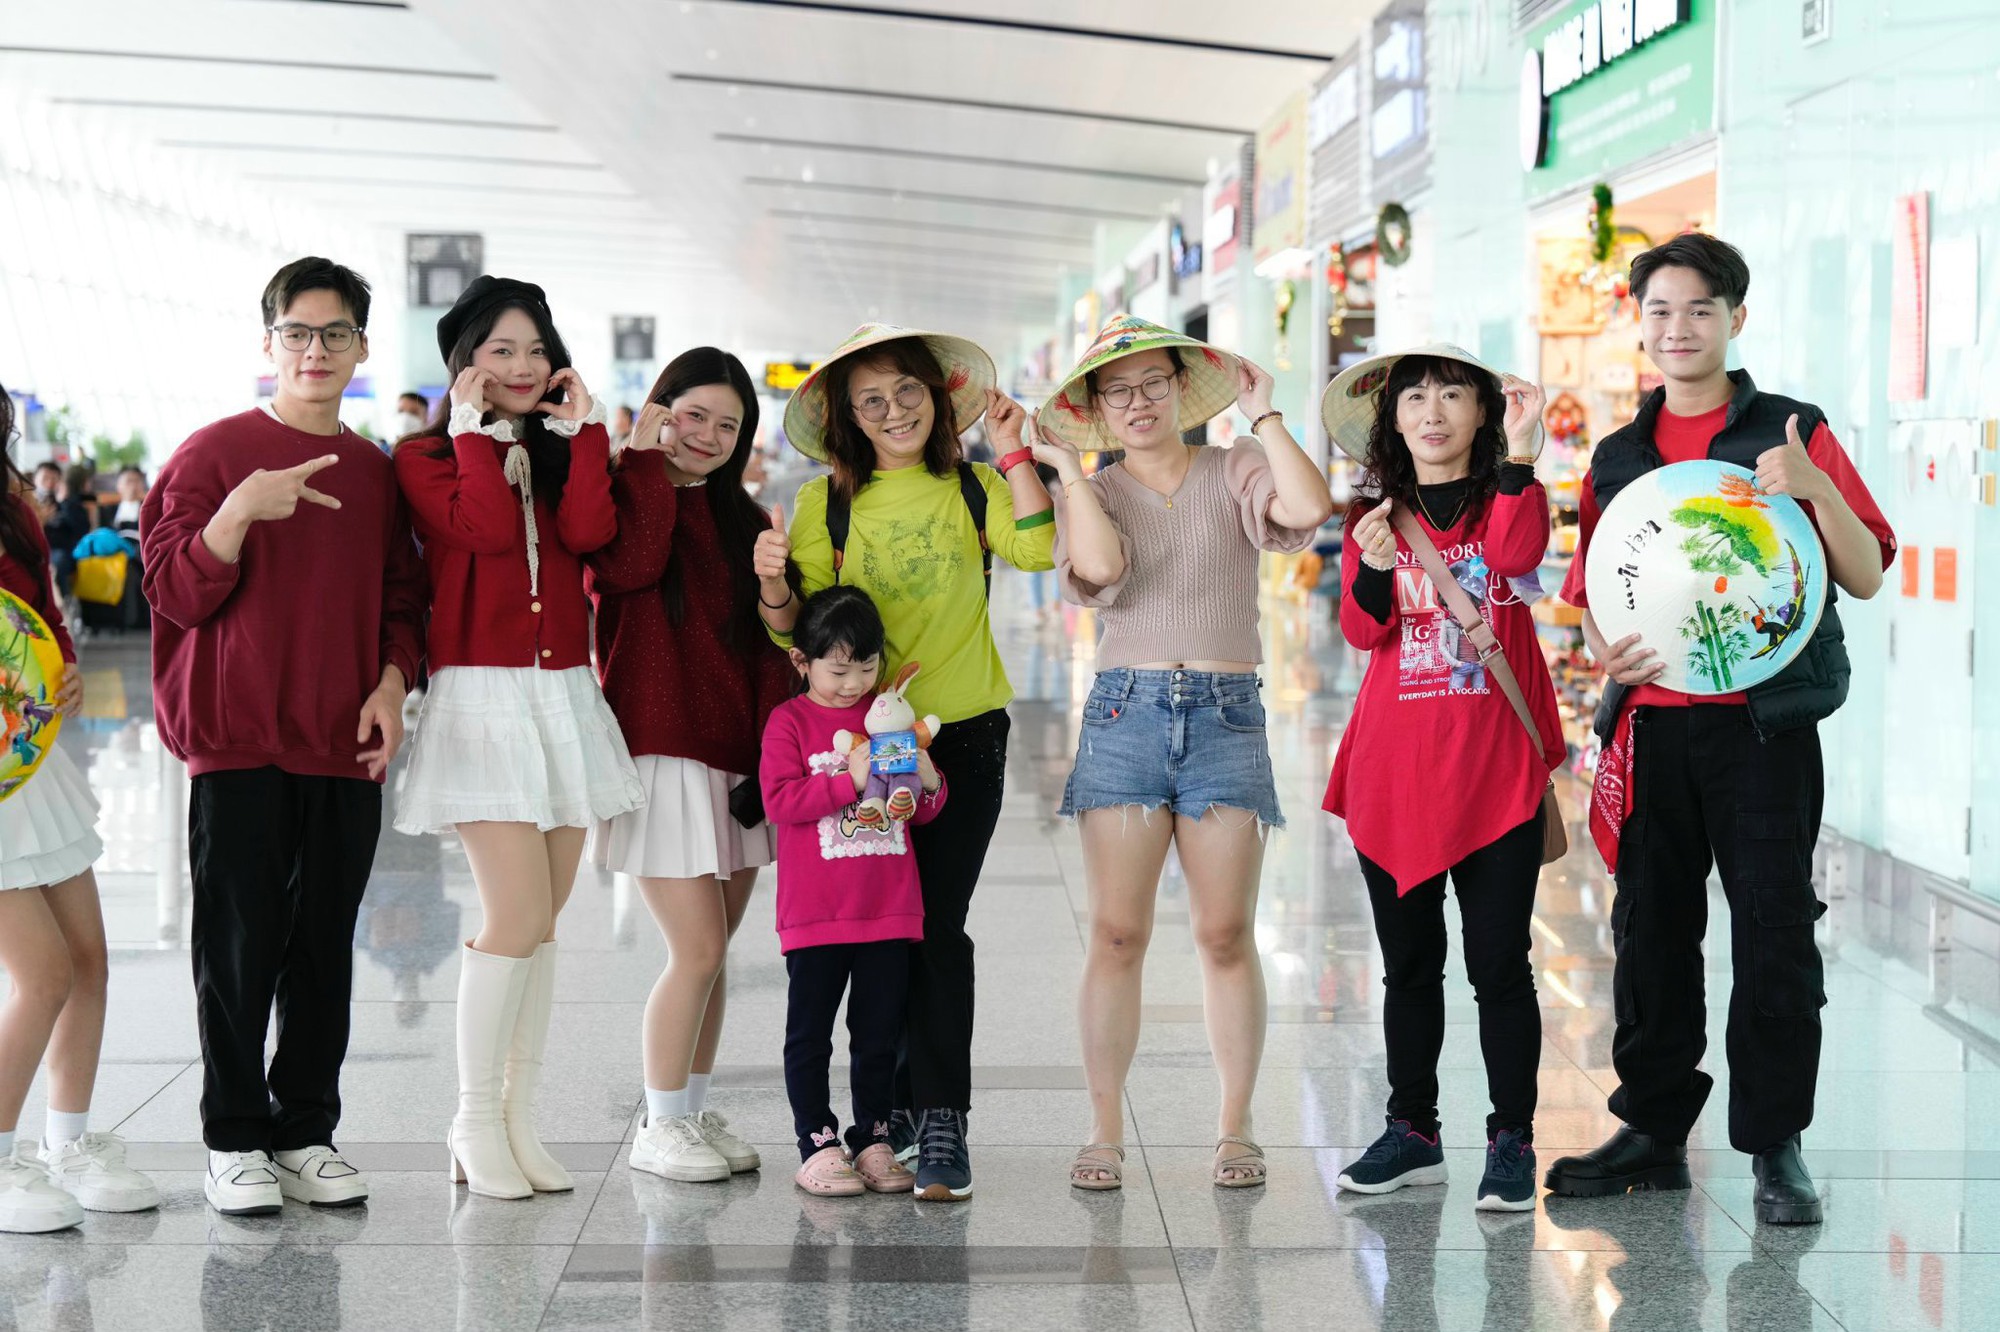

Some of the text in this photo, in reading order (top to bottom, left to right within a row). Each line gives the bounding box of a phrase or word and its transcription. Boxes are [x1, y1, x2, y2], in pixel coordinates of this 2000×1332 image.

[1398, 690, 1437, 701] EVERYDAY
[1438, 689, 1446, 697] IS
[1447, 688, 1454, 696] A
